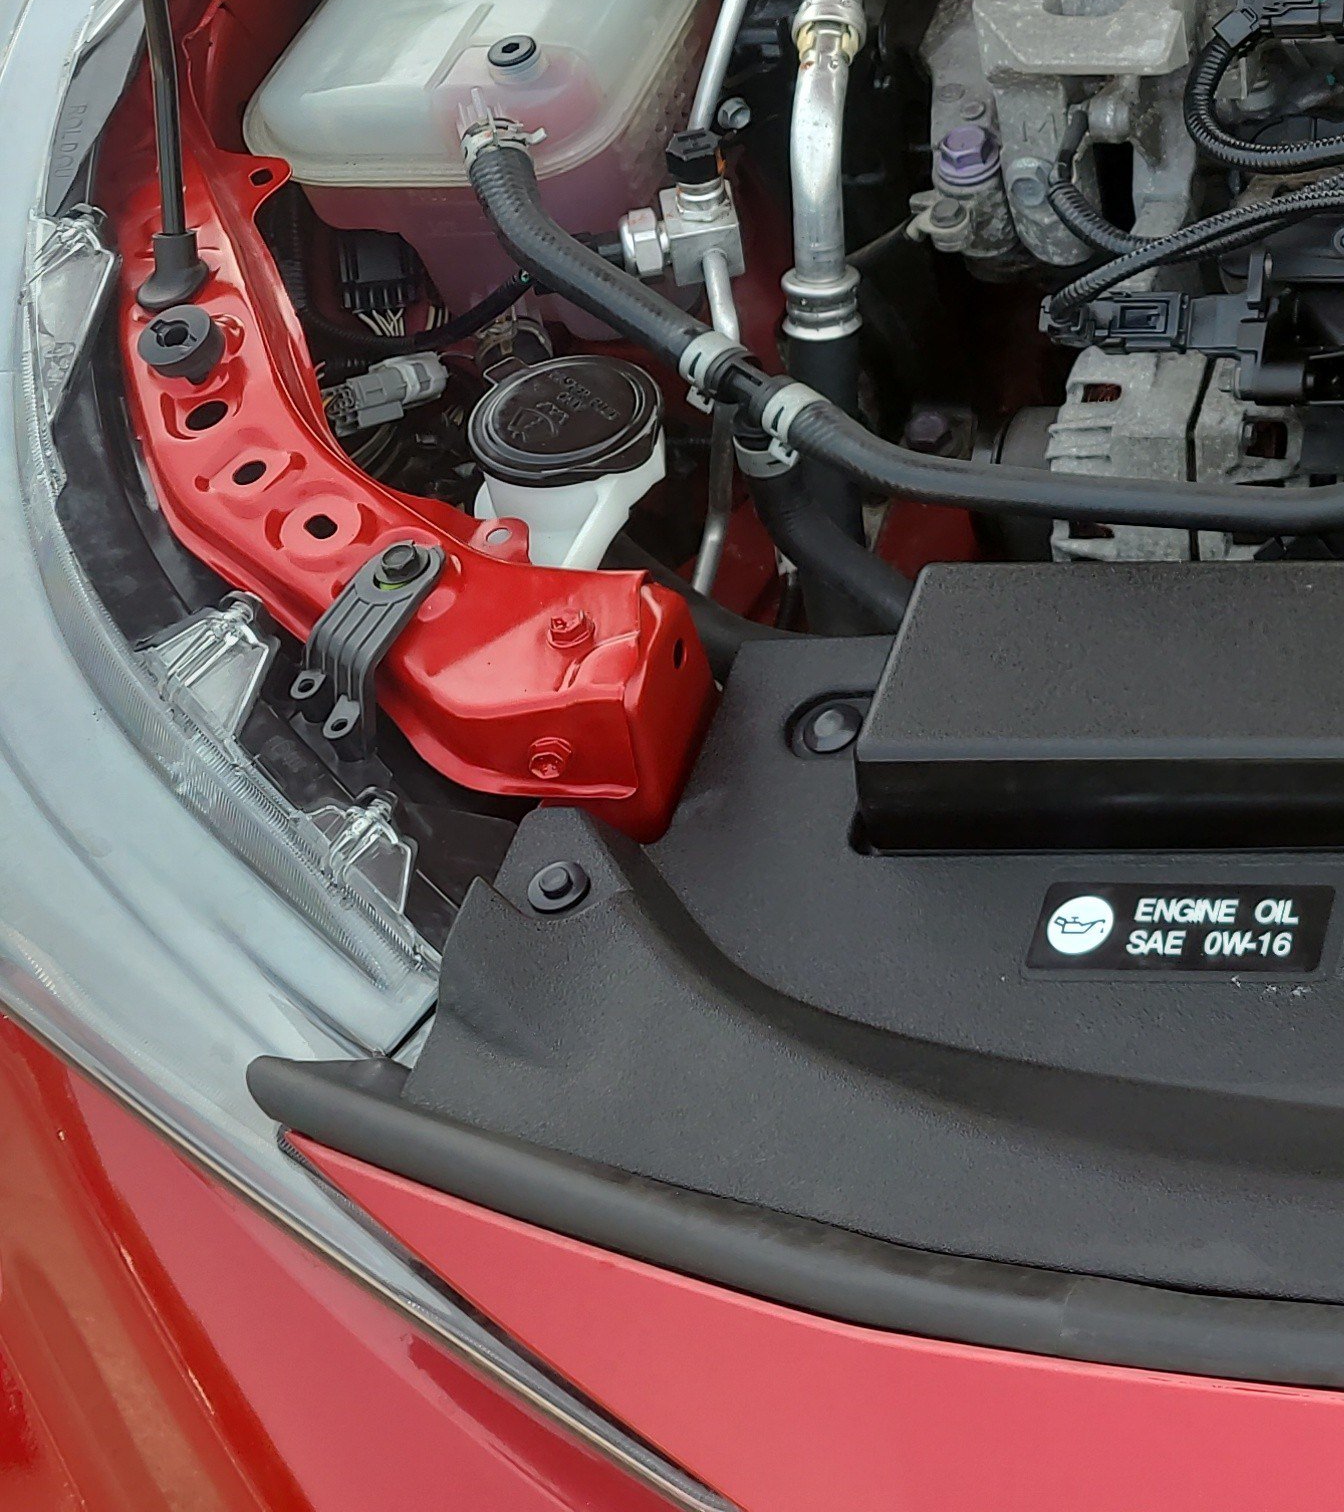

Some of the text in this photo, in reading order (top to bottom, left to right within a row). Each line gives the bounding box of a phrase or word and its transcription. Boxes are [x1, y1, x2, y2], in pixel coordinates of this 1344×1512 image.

[1134, 898, 1298, 924] ENGINE OIL
[1126, 930, 1292, 956] SAE 0W-16
